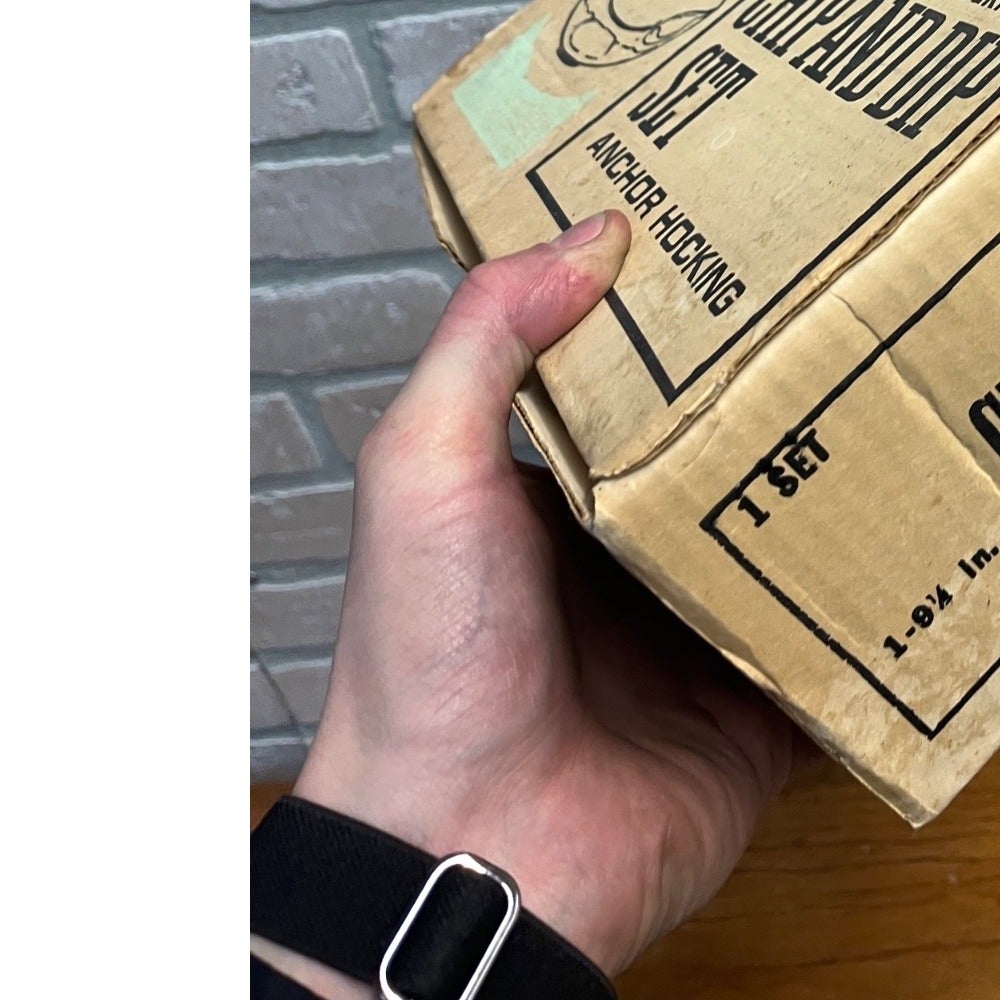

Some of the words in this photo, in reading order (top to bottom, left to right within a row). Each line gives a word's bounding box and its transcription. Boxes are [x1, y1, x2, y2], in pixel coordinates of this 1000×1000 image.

[626, 43, 759, 151] SET
[586, 131, 668, 221] ANCHOR
[649, 204, 747, 317] HOCKING
[737, 495, 771, 528] 1
[766, 427, 830, 498] SET
